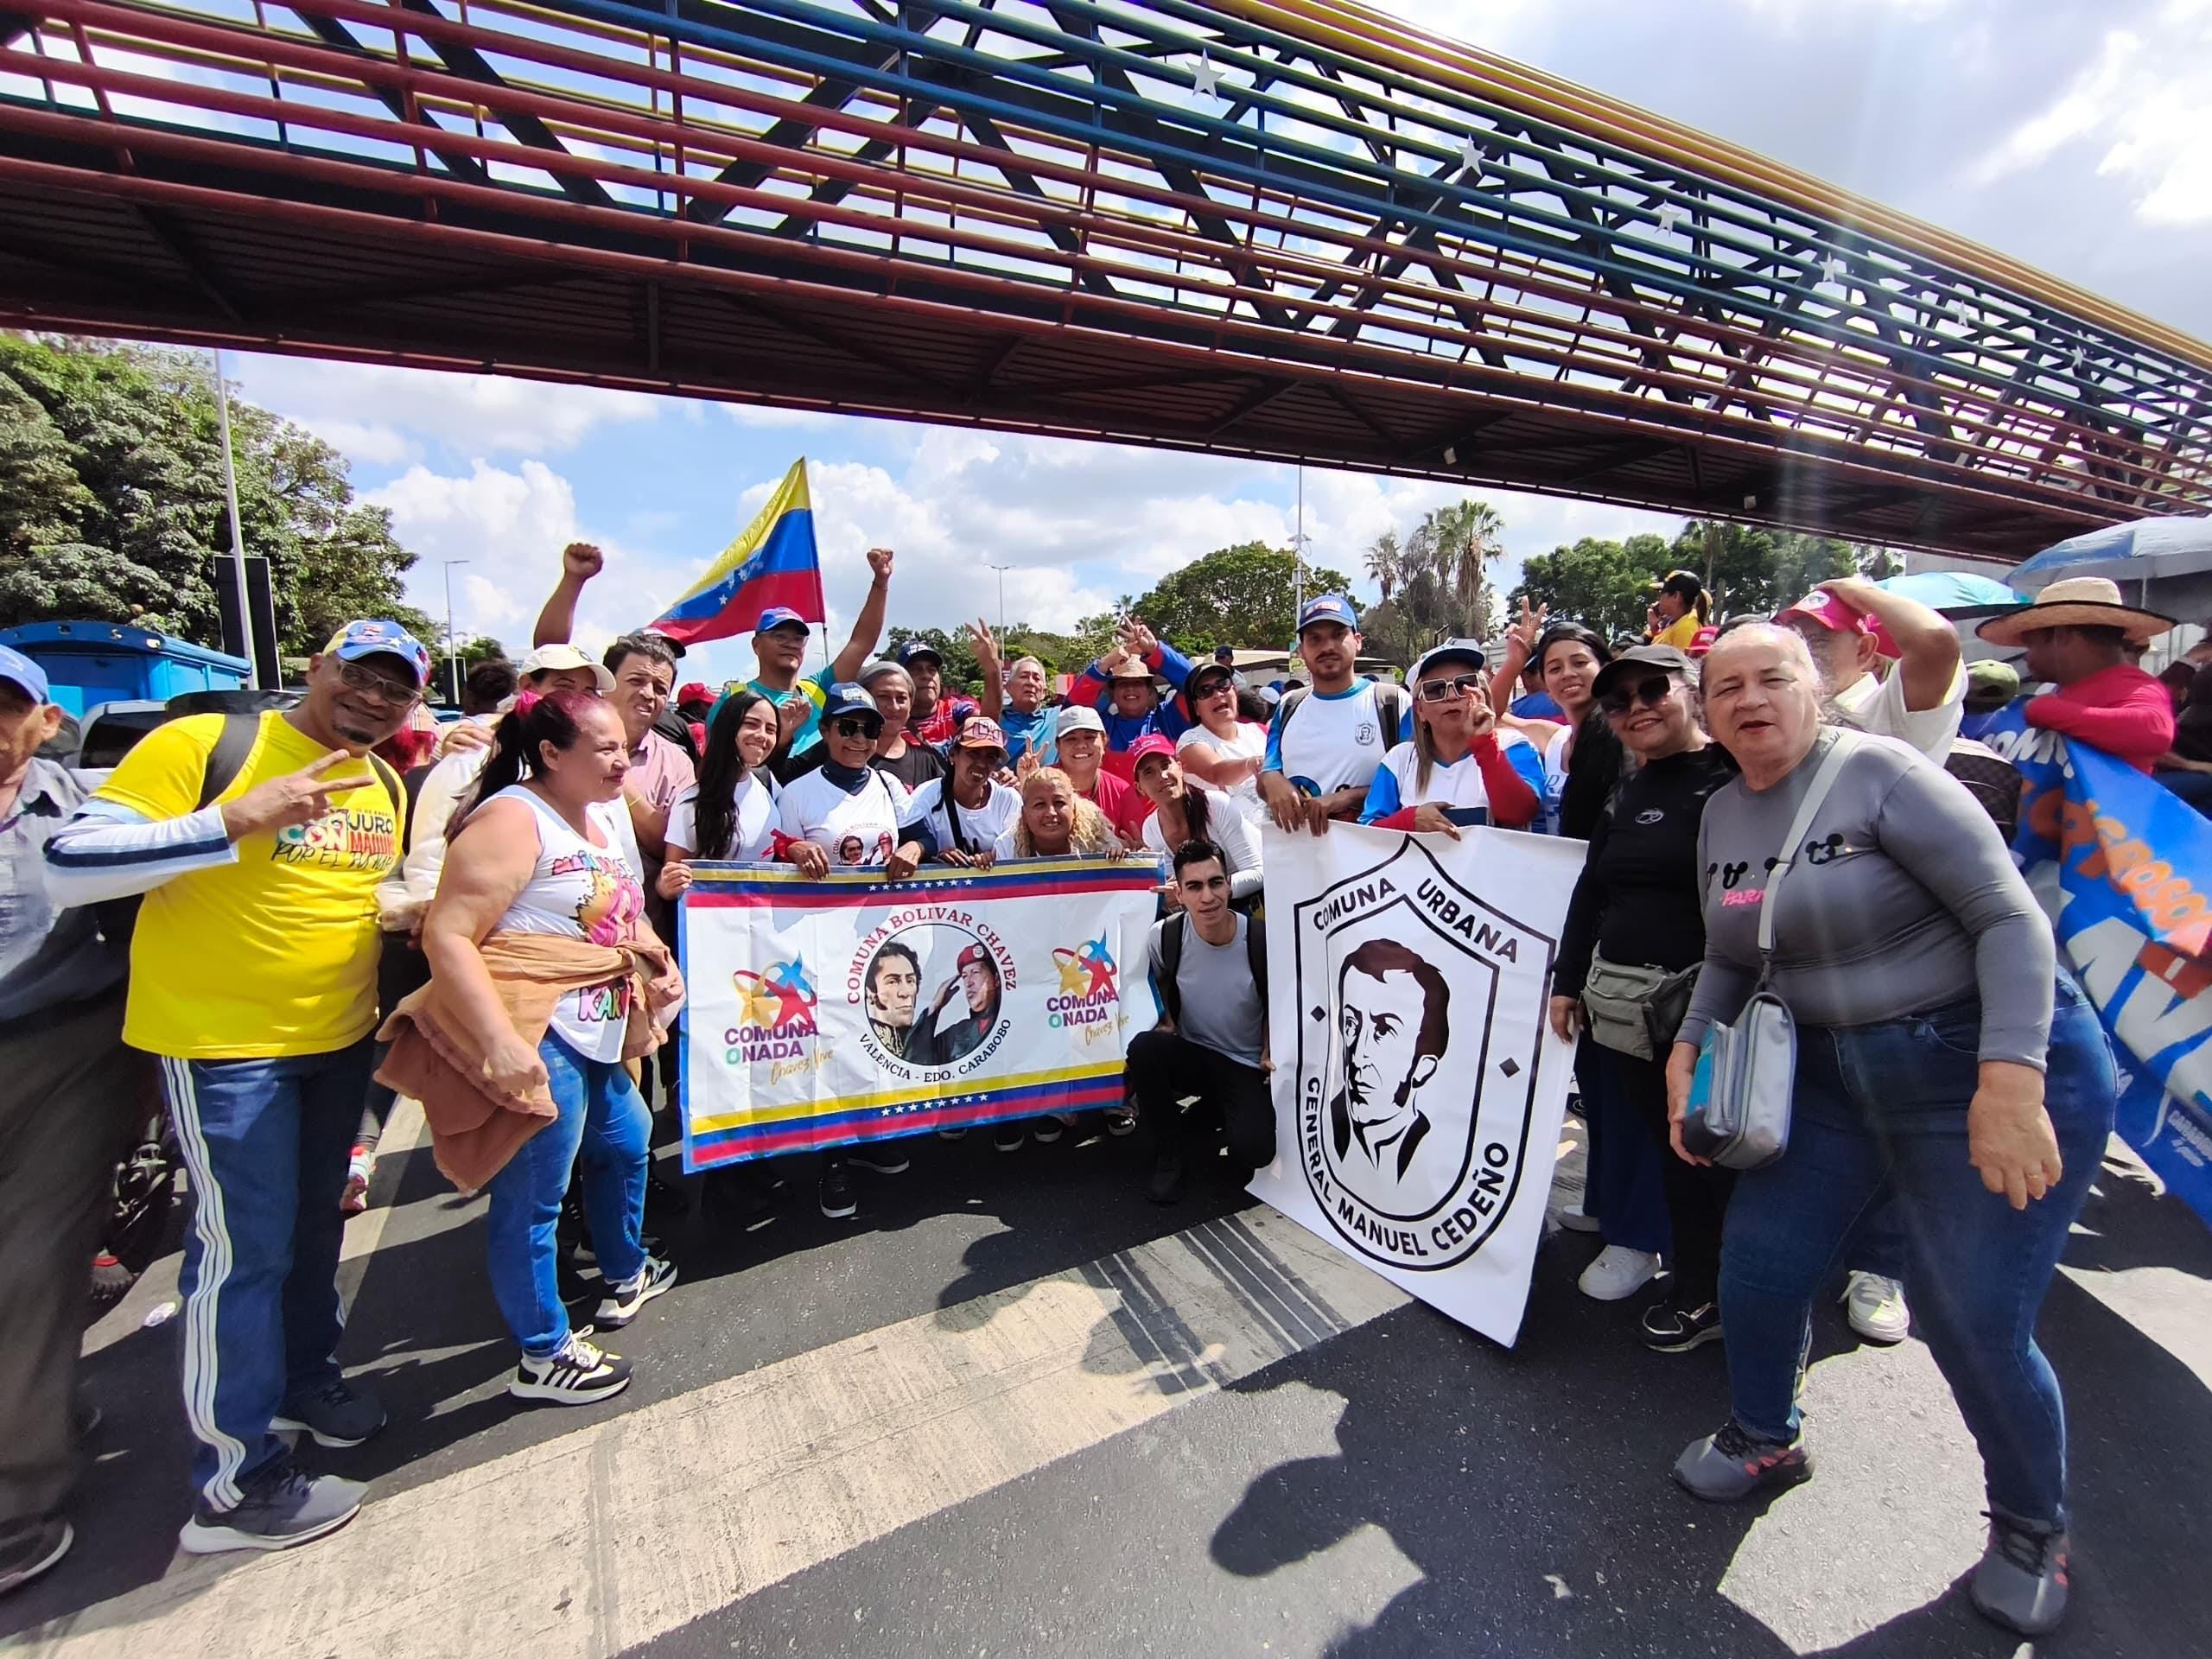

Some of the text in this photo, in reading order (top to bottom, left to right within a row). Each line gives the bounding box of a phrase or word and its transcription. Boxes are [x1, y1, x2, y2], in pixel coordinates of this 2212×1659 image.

[270, 842, 315, 863] POR
[320, 849, 340, 867] EL
[1313, 877, 1518, 963] COMUNA URBANA
[847, 907, 1017, 1005] COMUNA BOLIVAR CHAVEZ
[1046, 990, 1119, 1012] COMUNA
[1048, 1007, 1108, 1028] ONADA
[724, 1020, 819, 1046] COMUNA
[726, 1040, 804, 1065] ONADA
[860, 1033, 911, 1080] VALENCIA
[924, 1070, 955, 1083] EDO.
[958, 1019, 1011, 1075] CARABOBO
[1306, 1077, 1509, 1256] GENERAL MANUEL CEDEÑO
